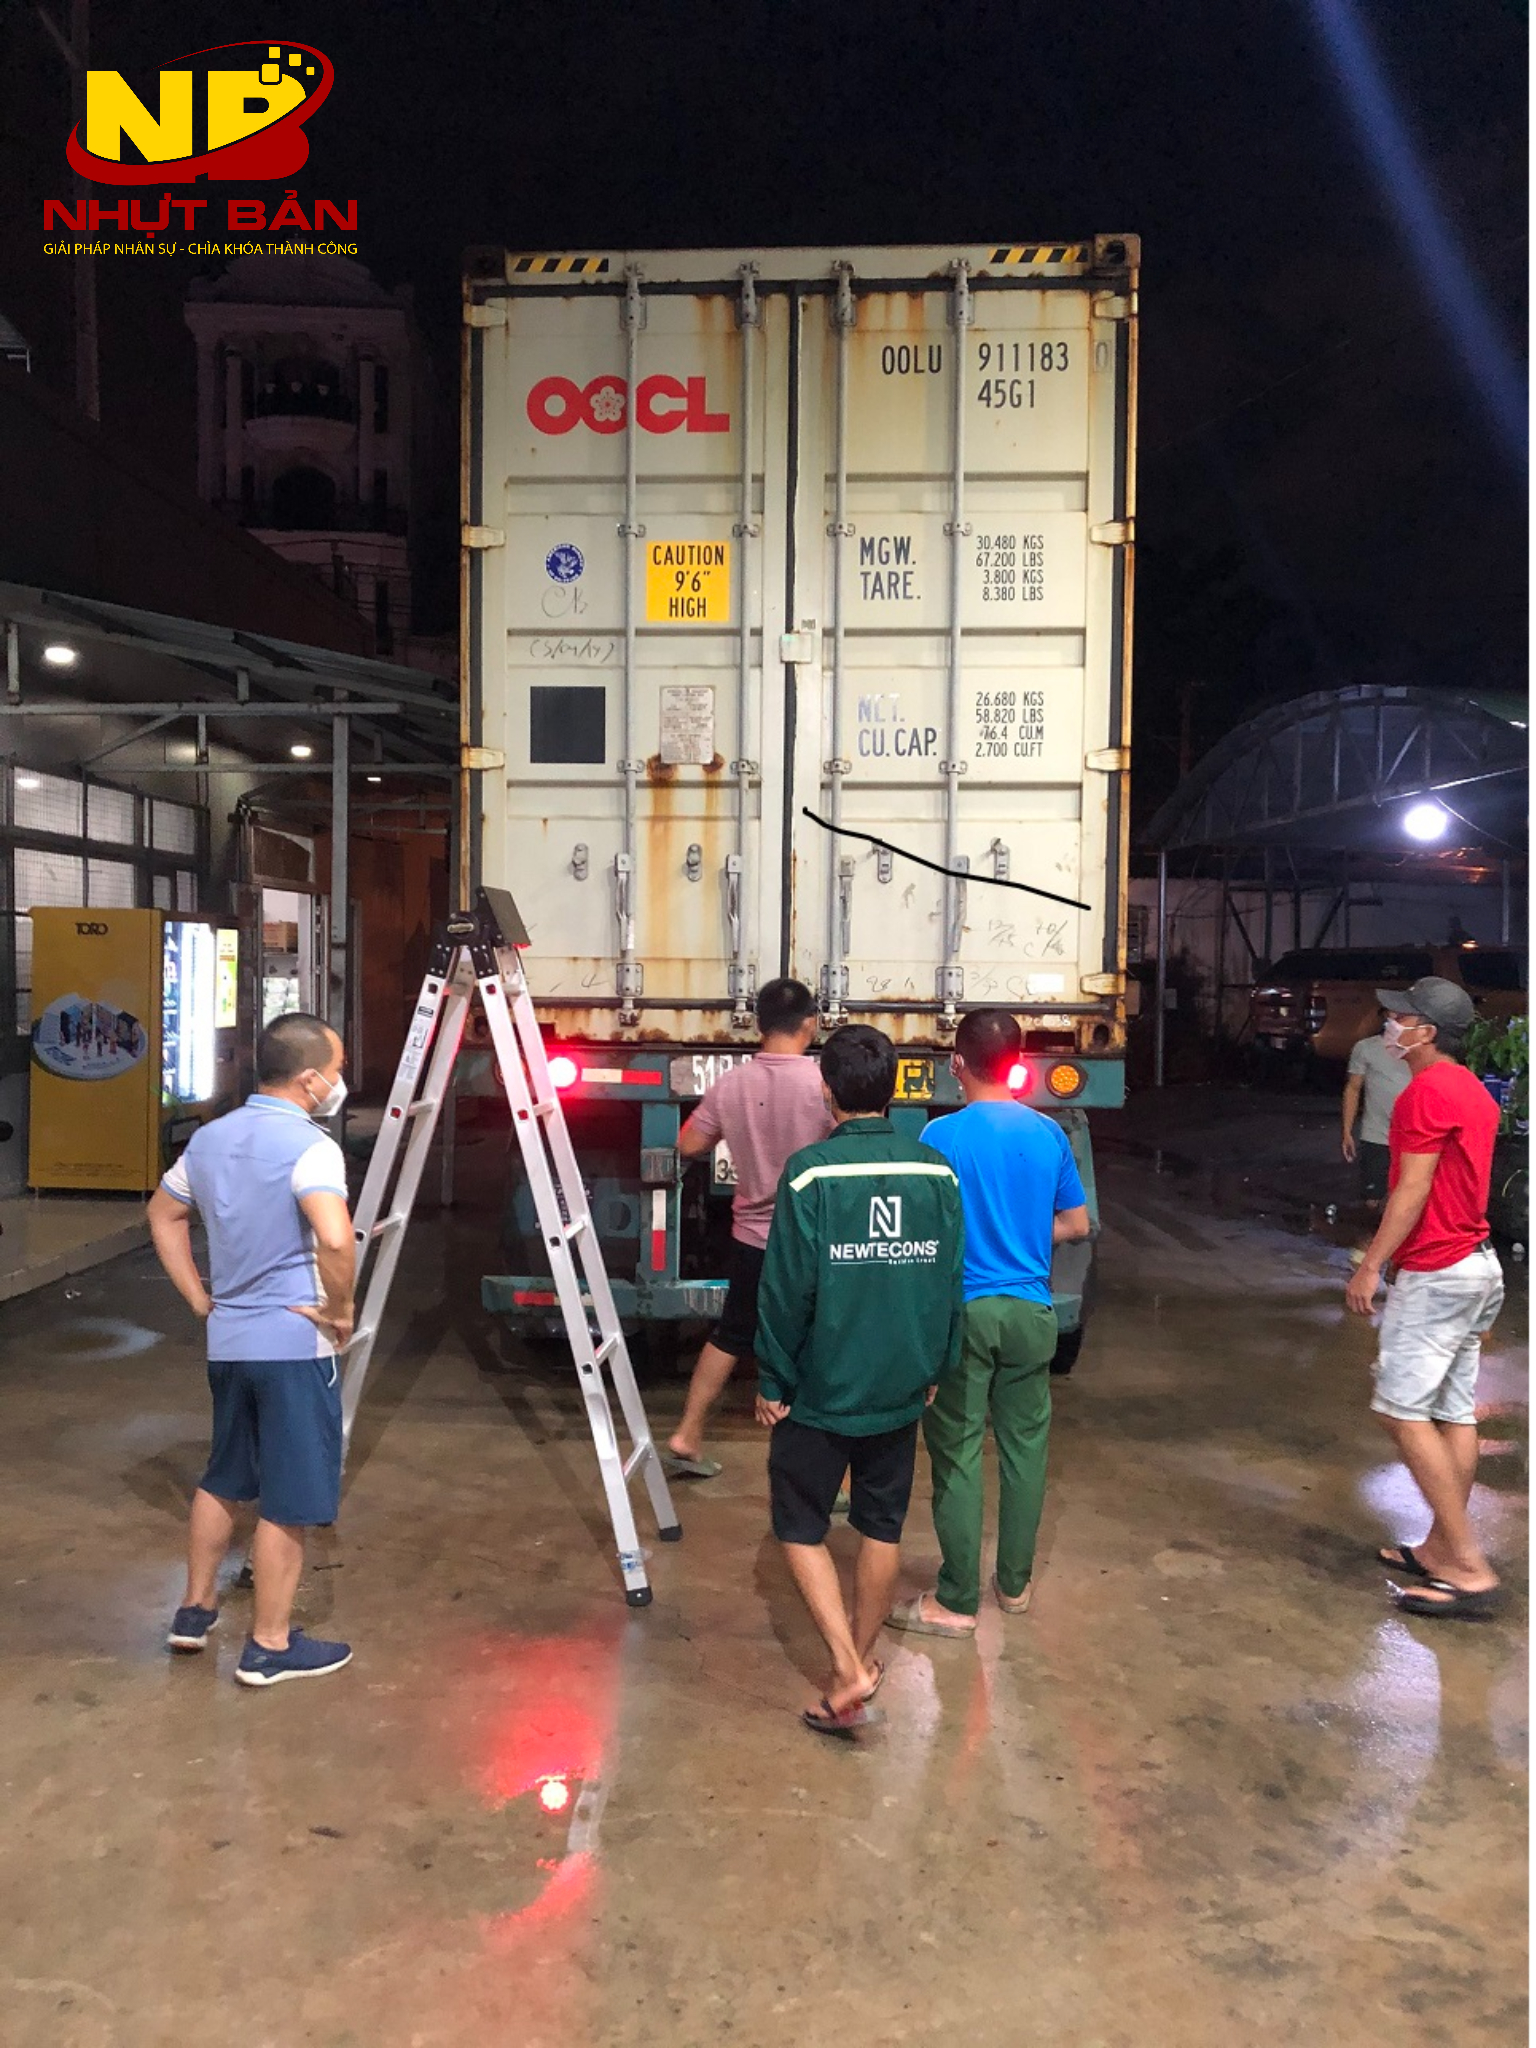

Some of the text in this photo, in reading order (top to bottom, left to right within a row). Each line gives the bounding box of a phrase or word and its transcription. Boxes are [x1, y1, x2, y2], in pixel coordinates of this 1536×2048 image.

[978, 342, 1069, 372] 911183
[977, 379, 1035, 409] 45G1
[526, 374, 730, 436] OOCL
[860, 536, 917, 566] MGW.
[976, 535, 1044, 550] 30.480 KGS
[653, 545, 724, 566] CAUTION
[976, 552, 1044, 567] 67.200 LBS
[982, 569, 1044, 584] 3.800 KGS
[860, 571, 922, 601] TARE.
[982, 586, 1044, 601] 8.380 LBS
[669, 597, 706, 618] HIGH
[975, 691, 1044, 706] 26.680 KGS
[975, 708, 1044, 723] 58.820 LBS
[975, 742, 1008, 757] 2.700
[75, 922, 109, 935] TORO
[829, 1240, 938, 1260] NEWTECONS
